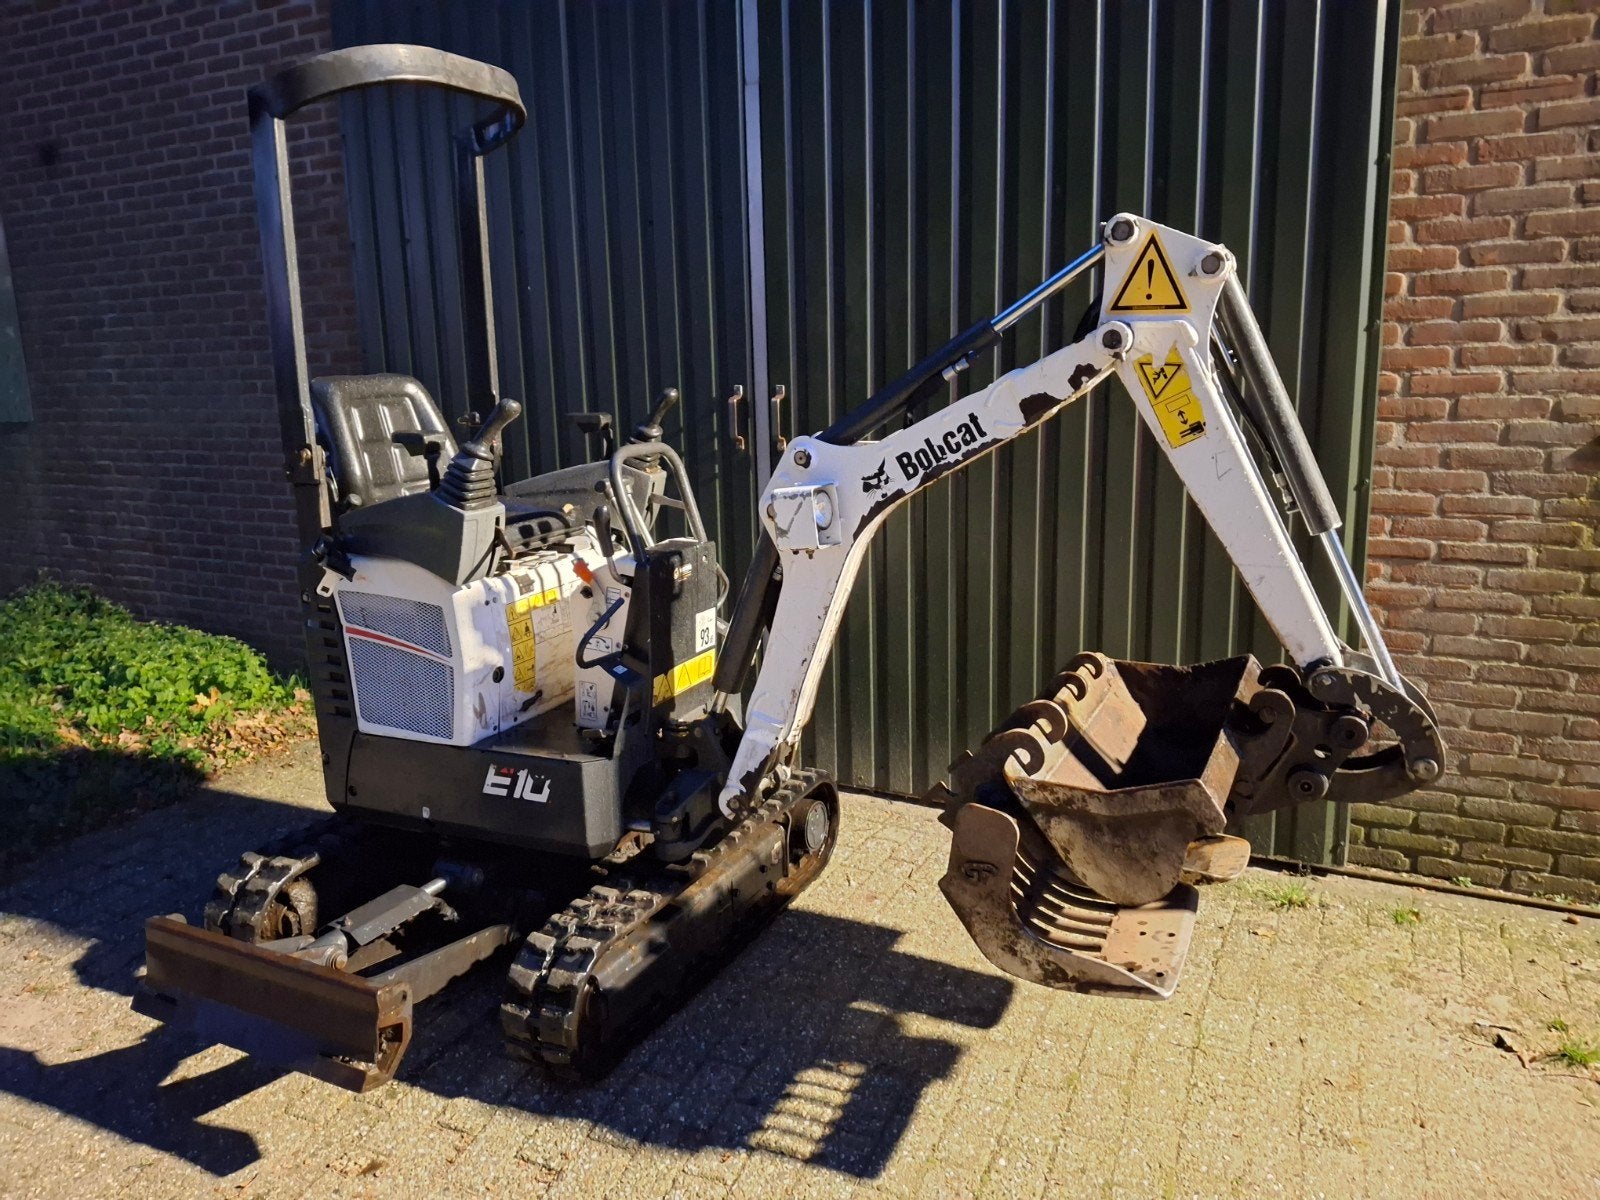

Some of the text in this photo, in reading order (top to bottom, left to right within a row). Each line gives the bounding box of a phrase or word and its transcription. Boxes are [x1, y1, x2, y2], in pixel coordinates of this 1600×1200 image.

[895, 412, 987, 481] Bobcat
[700, 627, 710, 647] 93
[482, 763, 551, 803] E10
